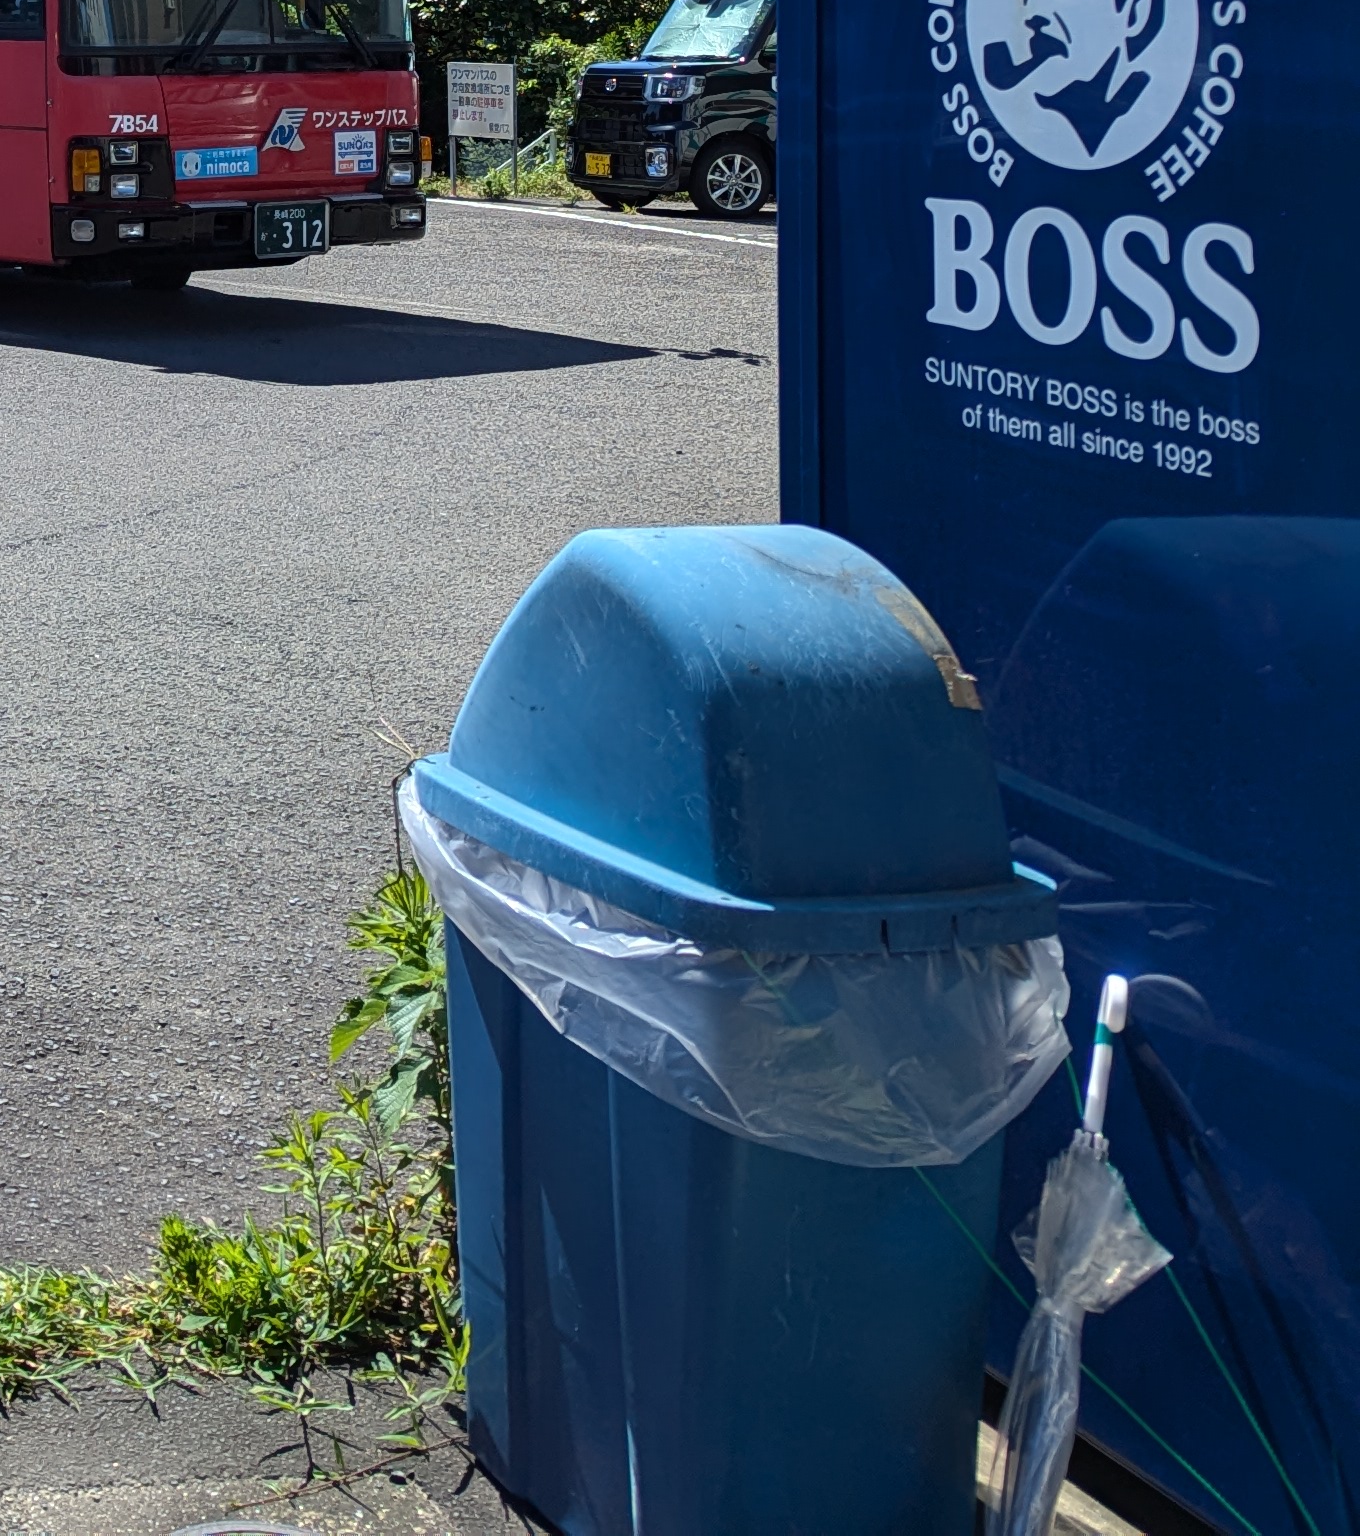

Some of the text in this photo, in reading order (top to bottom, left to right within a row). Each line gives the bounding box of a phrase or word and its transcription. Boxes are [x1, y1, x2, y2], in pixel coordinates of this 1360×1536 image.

[451, 68, 497, 81] ワンマンバスの
[109, 114, 159, 133] 7B54
[312, 109, 408, 129] ワンステップバス
[942, 82, 1015, 188] BOSS
[1144, 43, 1243, 202] COFFEE
[206, 159, 250, 175] nimoca
[924, 197, 1260, 374] BOSS
[925, 357, 1261, 445] SUNTORY BOSS is the boss
[962, 403, 1213, 478] of them all since 1992
